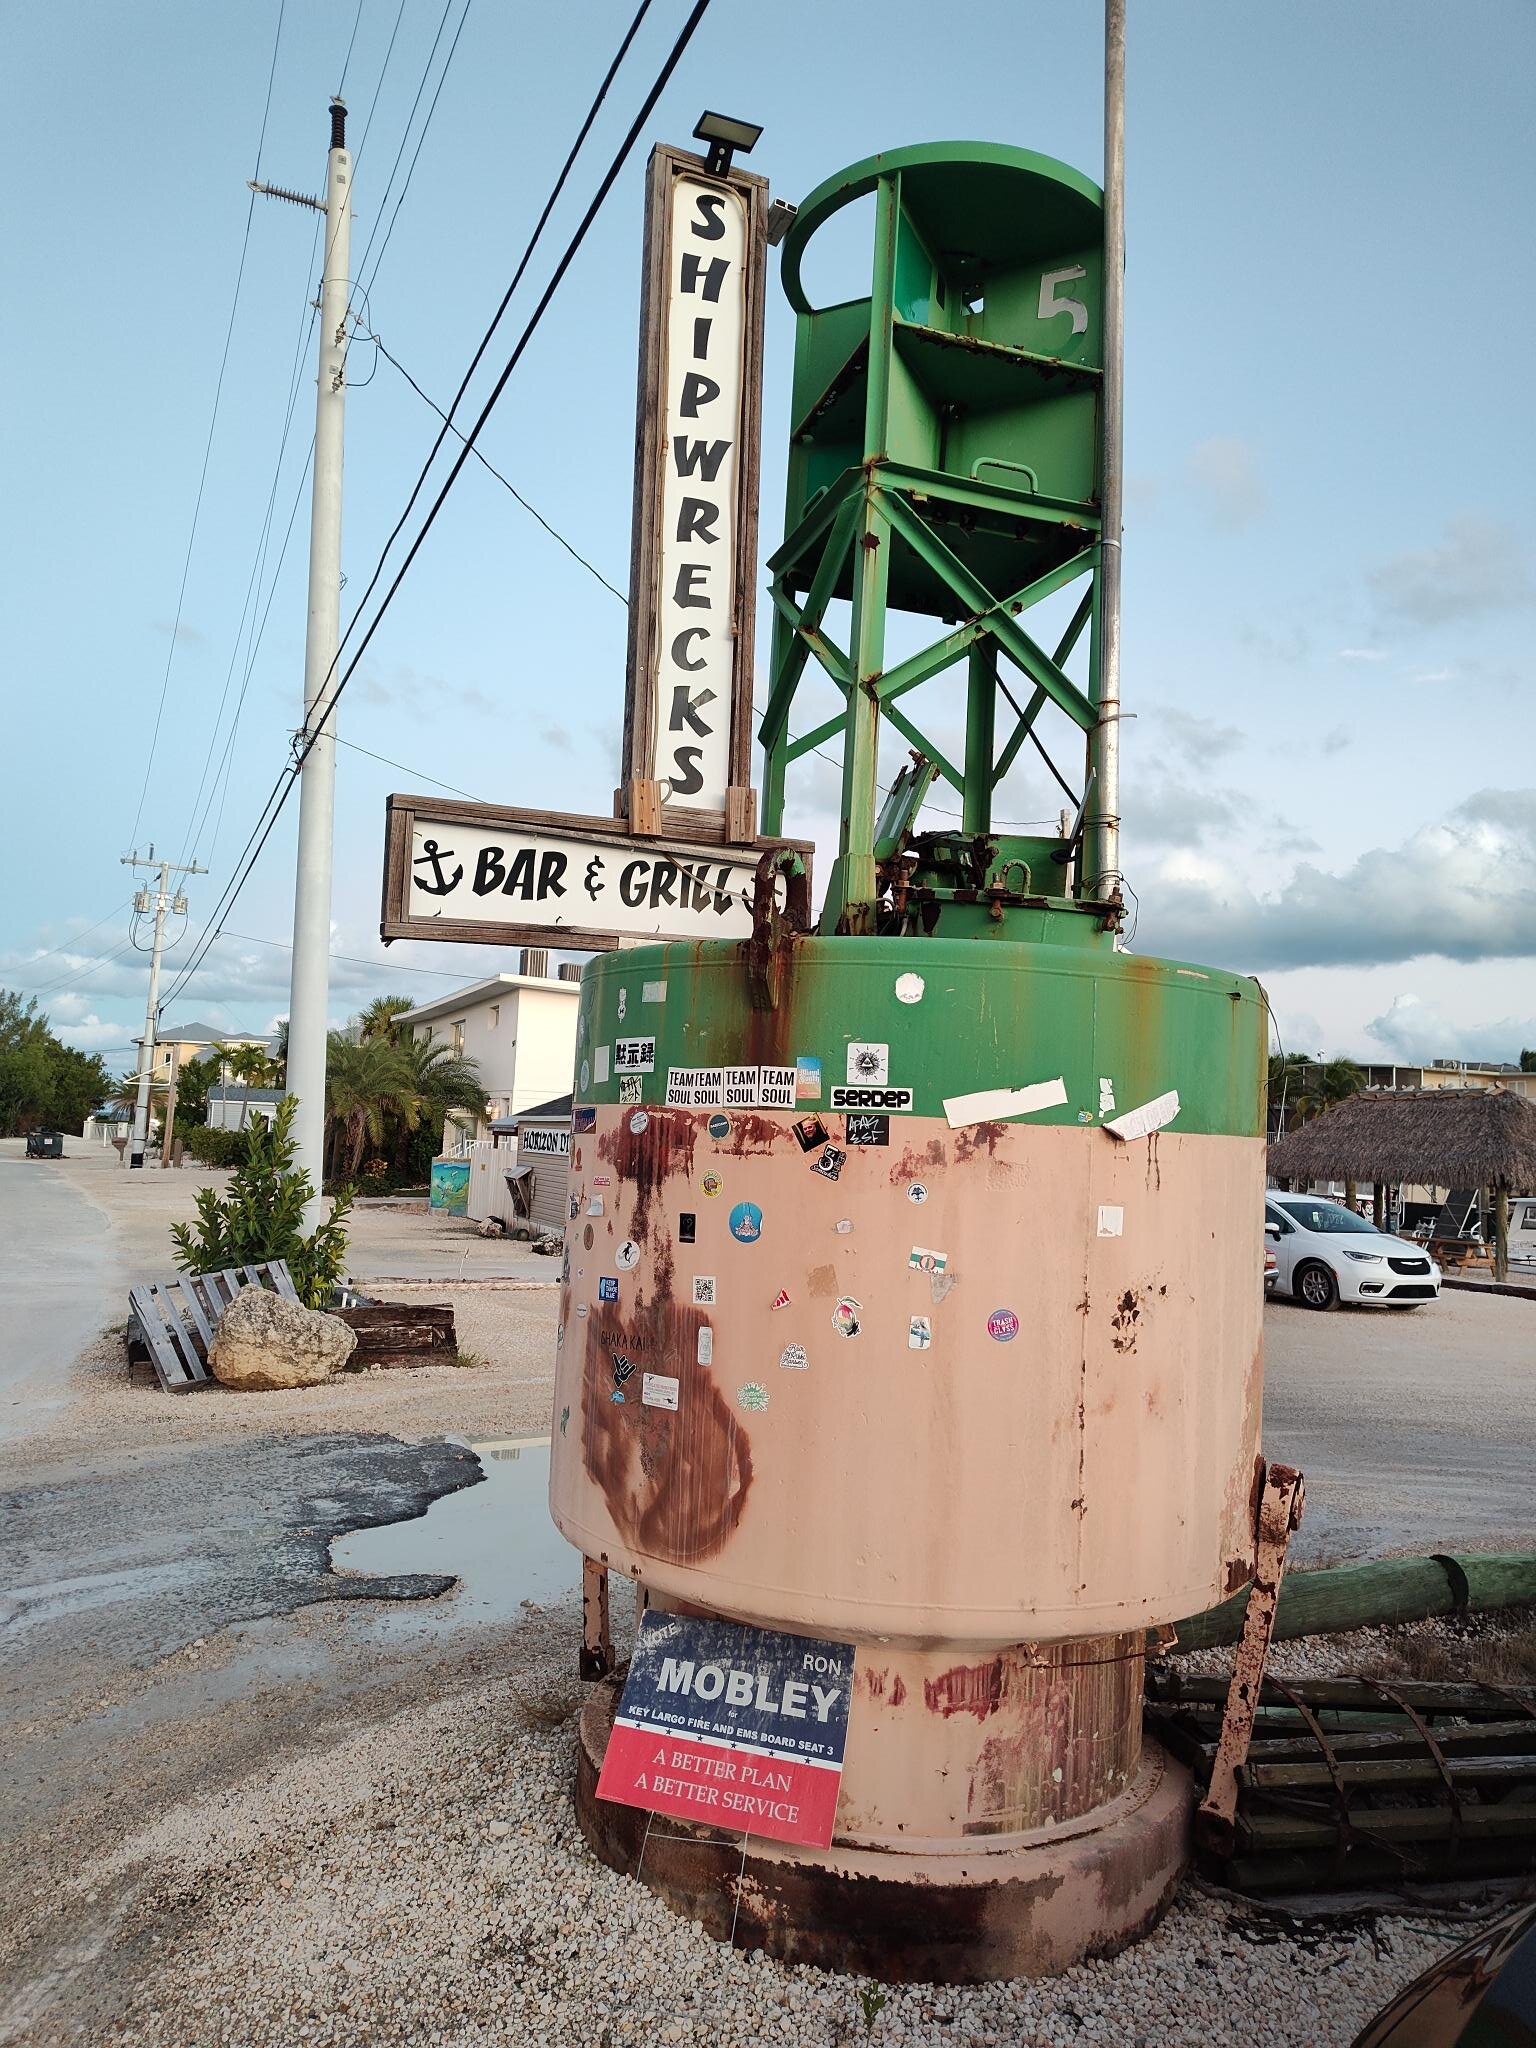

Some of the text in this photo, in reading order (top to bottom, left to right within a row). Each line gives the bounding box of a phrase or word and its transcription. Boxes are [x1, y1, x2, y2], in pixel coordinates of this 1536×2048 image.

[1037, 265, 1088, 334] 5
[667, 194, 733, 796] SHIPWRECKS
[473, 847, 735, 915] BAR & GRILL
[669, 1071, 694, 1087] TEAM
[726, 1070, 756, 1085] TEAM
[762, 1070, 795, 1086] TEAM
[668, 1089, 692, 1105] SOUL
[694, 1089, 721, 1104] SOUL
[726, 1088, 755, 1103] SOUL
[761, 1088, 793, 1104] SOUL
[523, 1130, 570, 1153] HORIZON DI
[992, 1316, 1014, 1327] TRASH
[641, 1621, 679, 1646] VOTE
[802, 1654, 842, 1676] RON
[656, 1657, 842, 1723] MOBLEY
[728, 1710, 738, 1719] for
[628, 1705, 834, 1756] KEY LARGO FIRE AND EMS BOARD SEAT 3
[652, 1748, 793, 1793] A BETTER PLAN
[634, 1772, 800, 1824] A BETTER SERVICE
